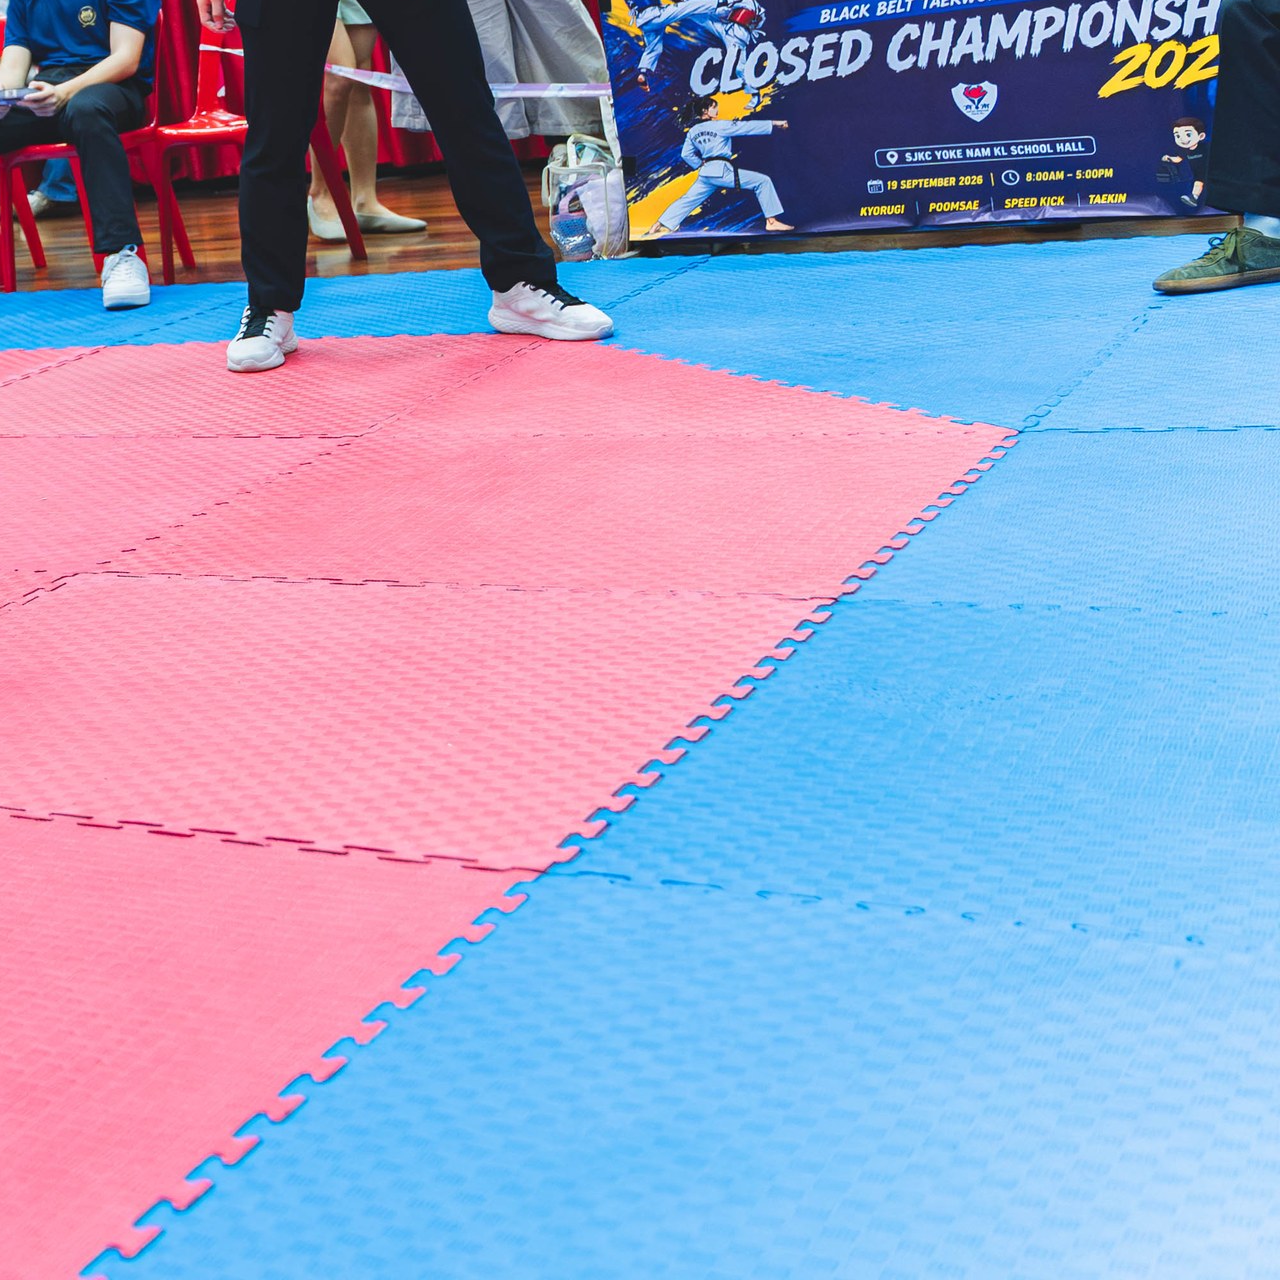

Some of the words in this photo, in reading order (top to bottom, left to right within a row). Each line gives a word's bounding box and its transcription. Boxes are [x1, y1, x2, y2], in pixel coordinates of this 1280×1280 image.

[819, 3, 870, 24] BLACK
[690, 29, 873, 97] CLOSED
[1097, 33, 1220, 99] 202
[905, 151, 933, 163] SJKC
[936, 148, 963, 161] YOKE
[966, 146, 991, 159] NAM
[993, 145, 1008, 157] KL
[1010, 143, 1053, 156] SCHOOL
[1056, 141, 1085, 153] HALL
[887, 180, 898, 191] 19
[900, 176, 956, 190] SEPTEMBER
[959, 174, 983, 186] 2026
[1025, 170, 1065, 182] 8:00AM
[1075, 167, 1114, 180] 5:00PM
[929, 200, 980, 213] POOMSAE
[1004, 197, 1037, 209] SPEED
[1040, 195, 1065, 207] KICK
[1089, 192, 1127, 205] TAEKIN
[860, 204, 905, 217] KYORUGI
